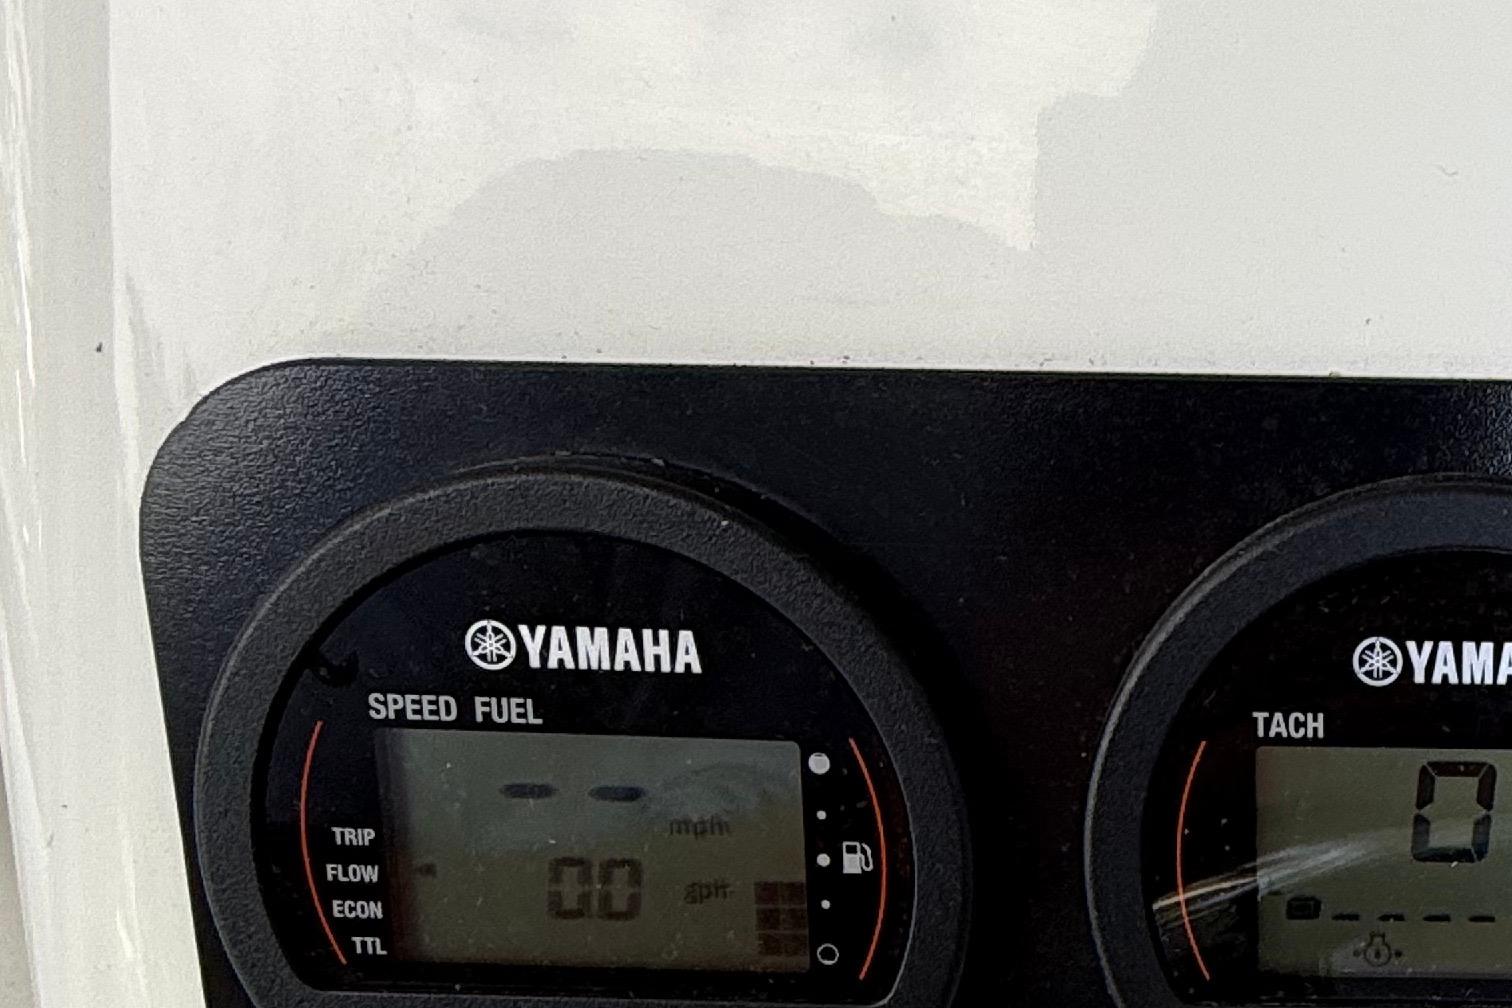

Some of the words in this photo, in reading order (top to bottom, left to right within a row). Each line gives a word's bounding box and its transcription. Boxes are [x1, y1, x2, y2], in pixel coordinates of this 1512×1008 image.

[518, 625, 702, 674] YAMAHA
[369, 693, 458, 722] SPEED
[475, 697, 544, 725] FUEL
[1253, 712, 1325, 740] TACH
[332, 827, 377, 847] TRIP
[326, 864, 380, 883] FLOW
[333, 900, 384, 920] ECON
[352, 937, 388, 956] TTL
